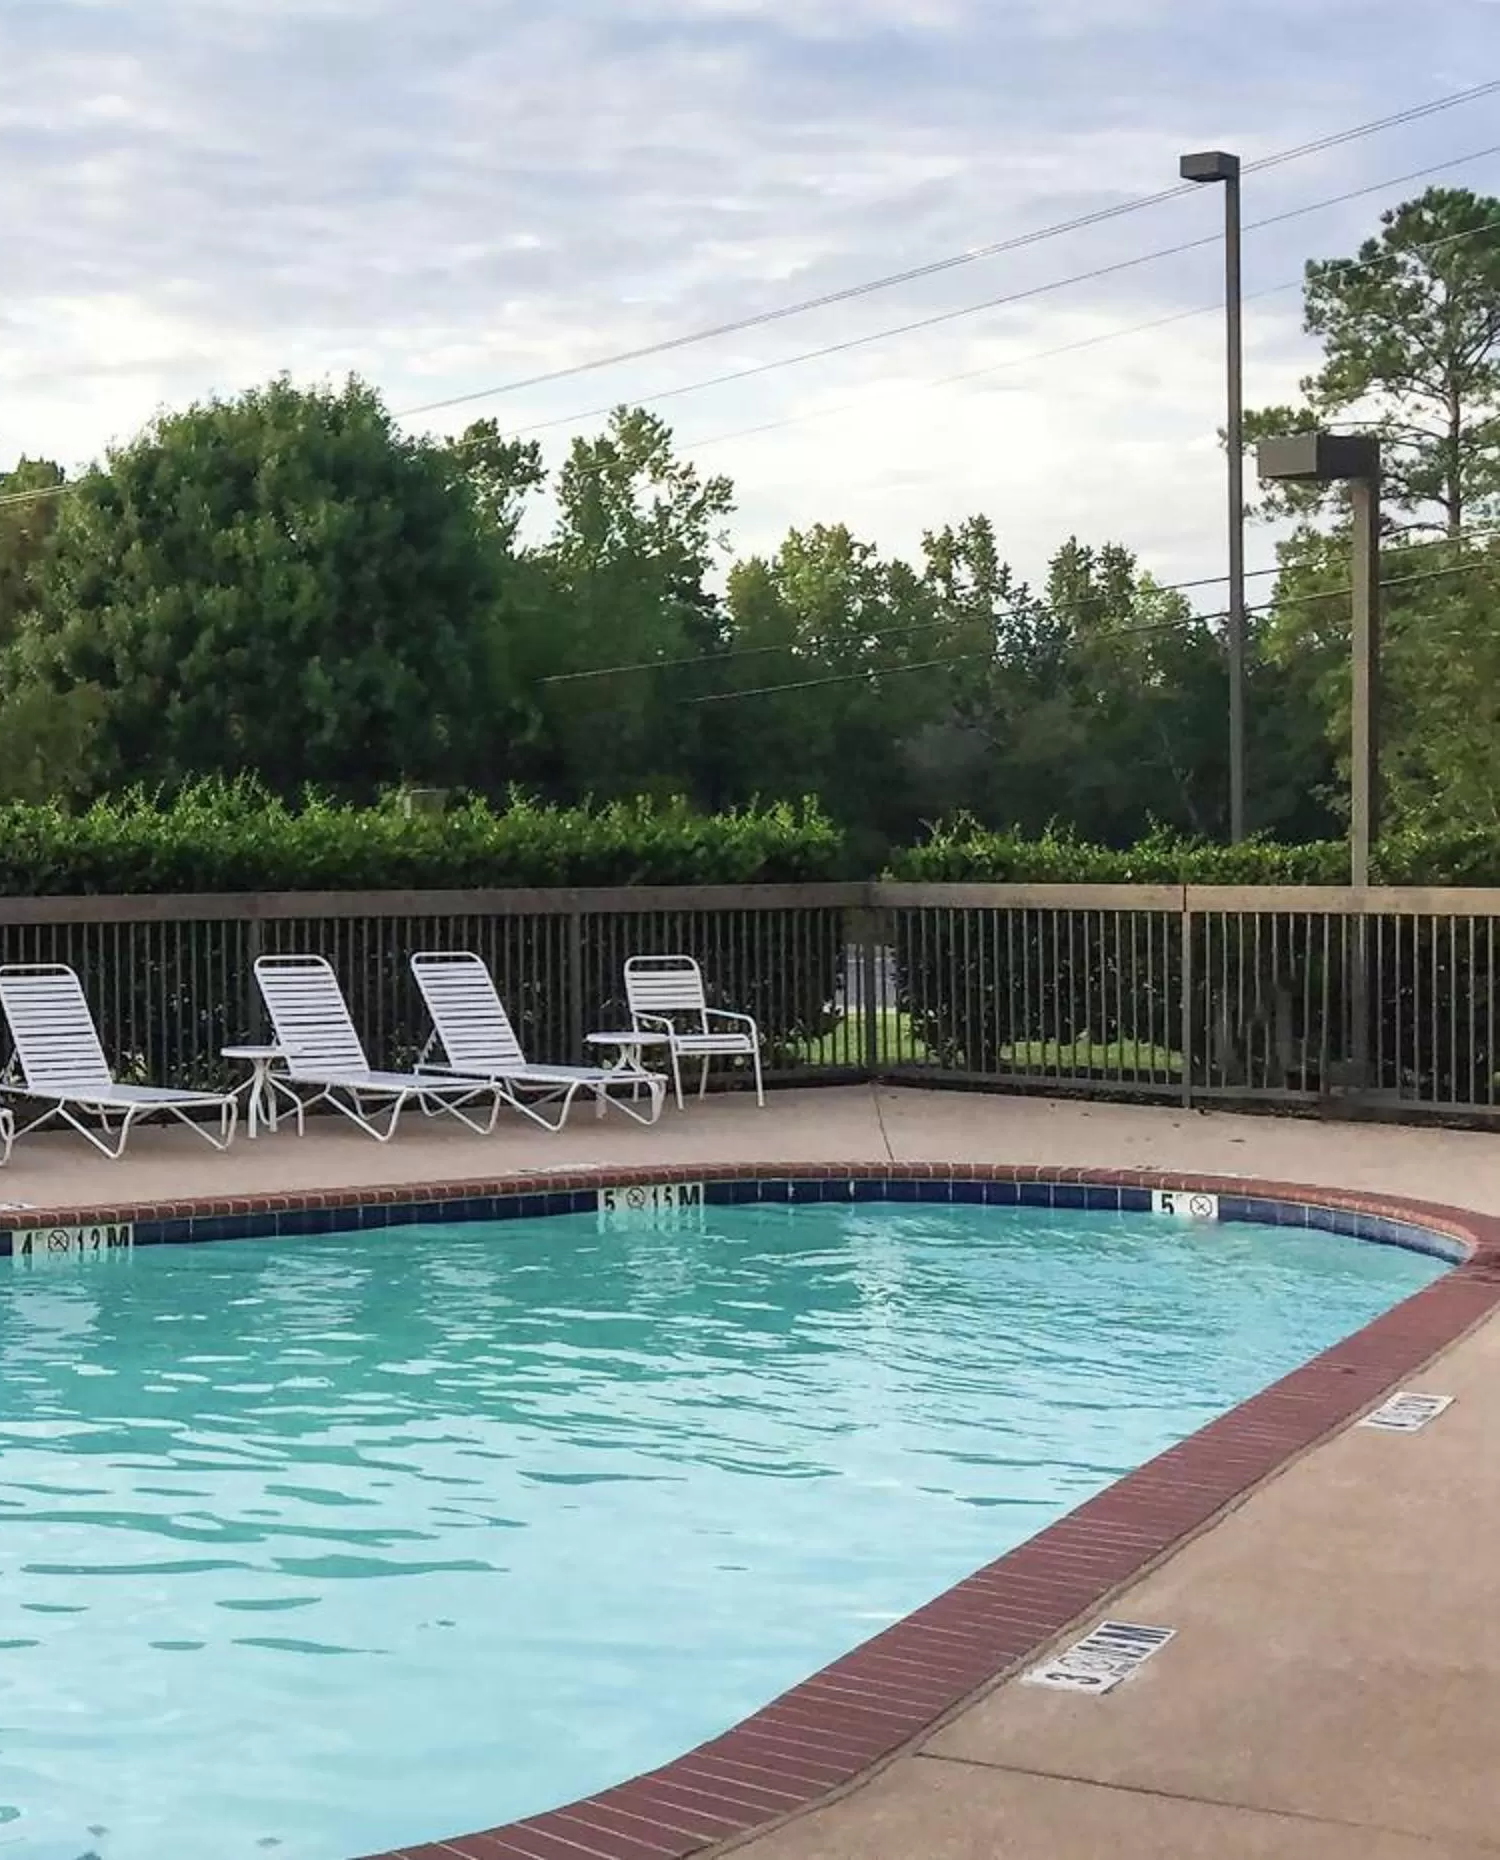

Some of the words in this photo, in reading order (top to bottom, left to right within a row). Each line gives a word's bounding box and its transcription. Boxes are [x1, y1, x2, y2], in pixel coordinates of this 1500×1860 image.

[1161, 1193, 1174, 1215] 5
[21, 1231, 32, 1254] 4
[1045, 1672, 1102, 1685] 3
